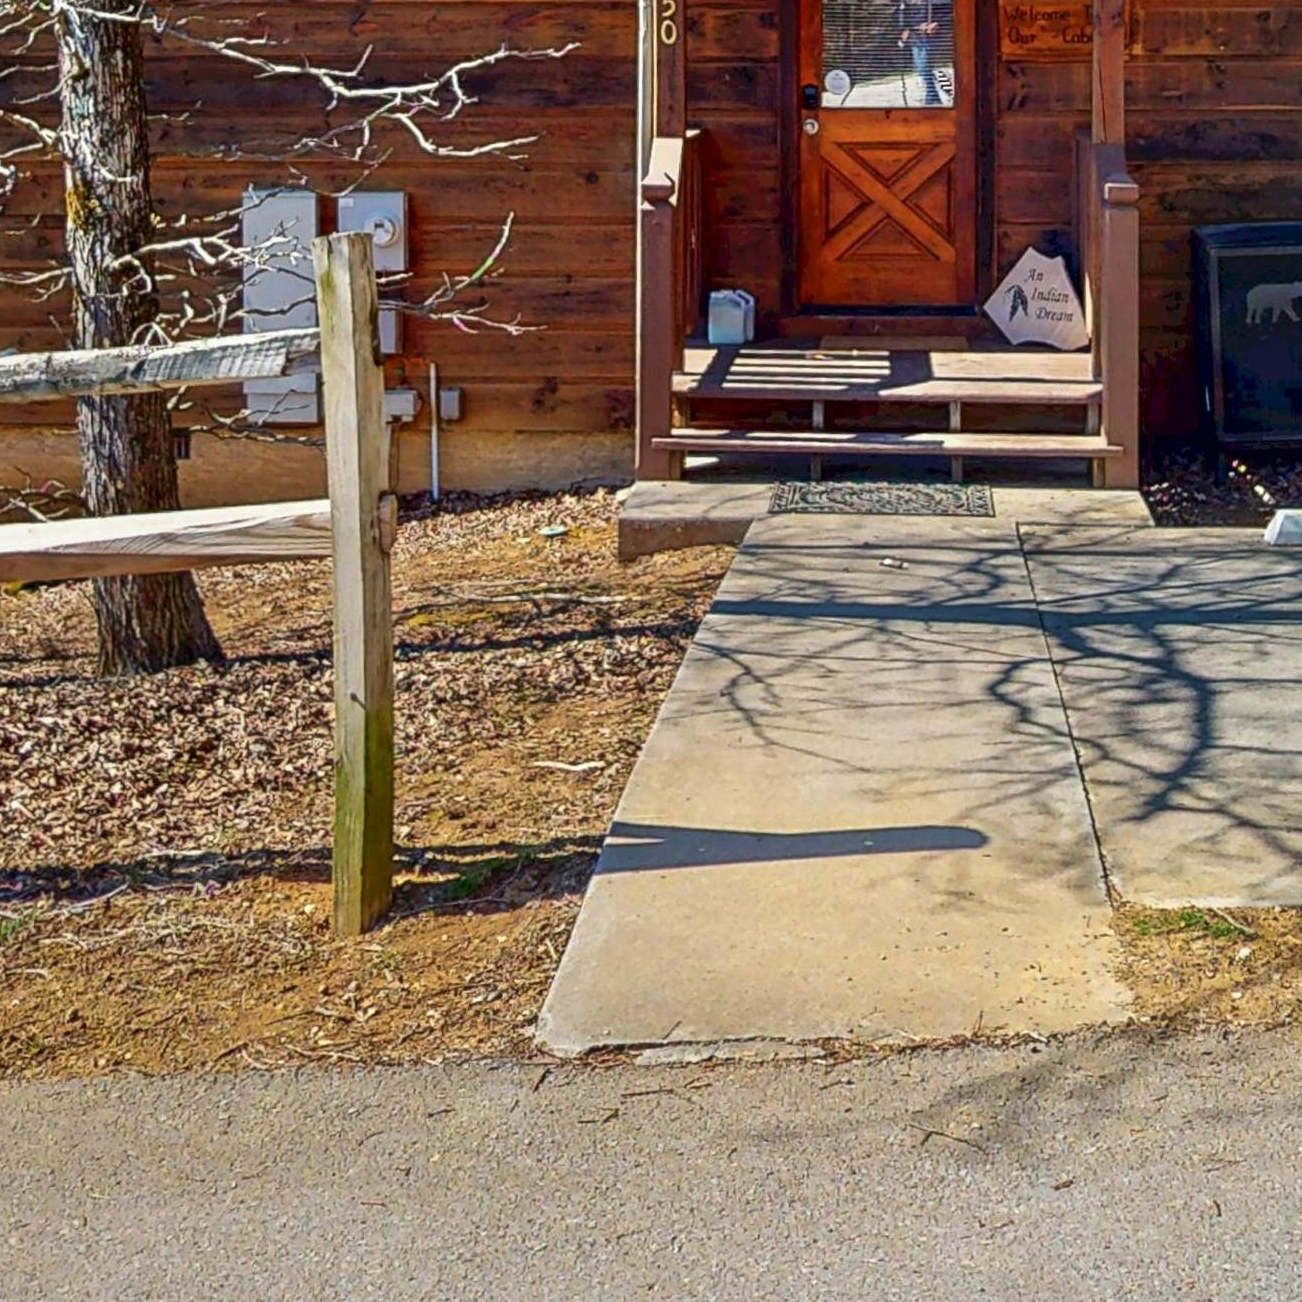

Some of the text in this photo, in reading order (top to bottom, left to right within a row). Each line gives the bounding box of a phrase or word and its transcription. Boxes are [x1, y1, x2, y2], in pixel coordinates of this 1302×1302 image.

[1002, 4, 1071, 21] Welcome
[1008, 25, 1094, 44] Our Cab
[1024, 268, 1044, 283] An
[1031, 286, 1070, 304] Indian
[1035, 306, 1074, 323] Dream
